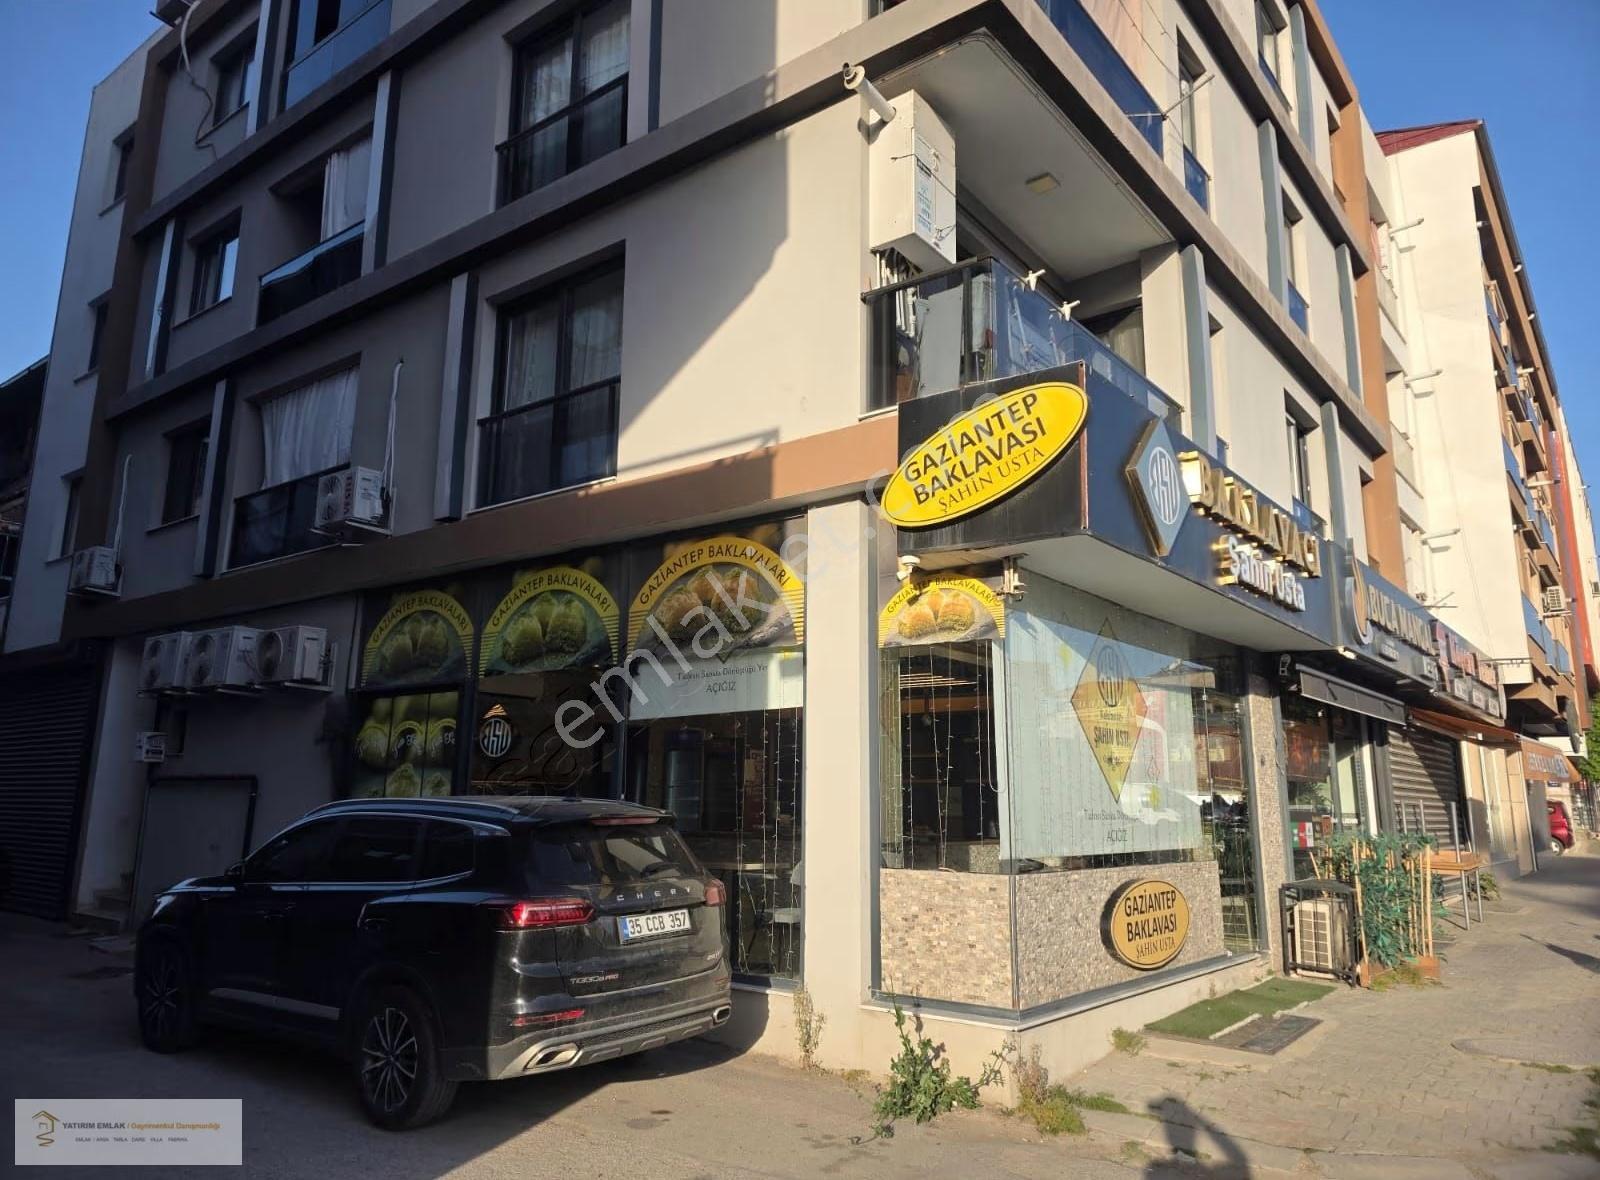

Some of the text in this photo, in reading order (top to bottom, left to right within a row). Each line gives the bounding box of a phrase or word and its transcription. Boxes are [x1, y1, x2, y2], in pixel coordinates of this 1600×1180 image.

[904, 393, 1038, 483] GAZİANTEP
[913, 417, 1047, 505] BAKLAVASI
[938, 447, 1045, 515] ŞAHİN USTA
[547, 573, 611, 612] BAKLAVALARI
[639, 548, 703, 605] GAZİANTEP
[616, 887, 692, 902] CHERY
[1124, 888, 1177, 917] GAZİANTEP
[629, 918, 642, 935] 35
[646, 914, 666, 932] CCB
[669, 912, 687, 929] 357
[1127, 913, 1178, 943] BAKLAVASI
[1158, 935, 1177, 952] USTA
